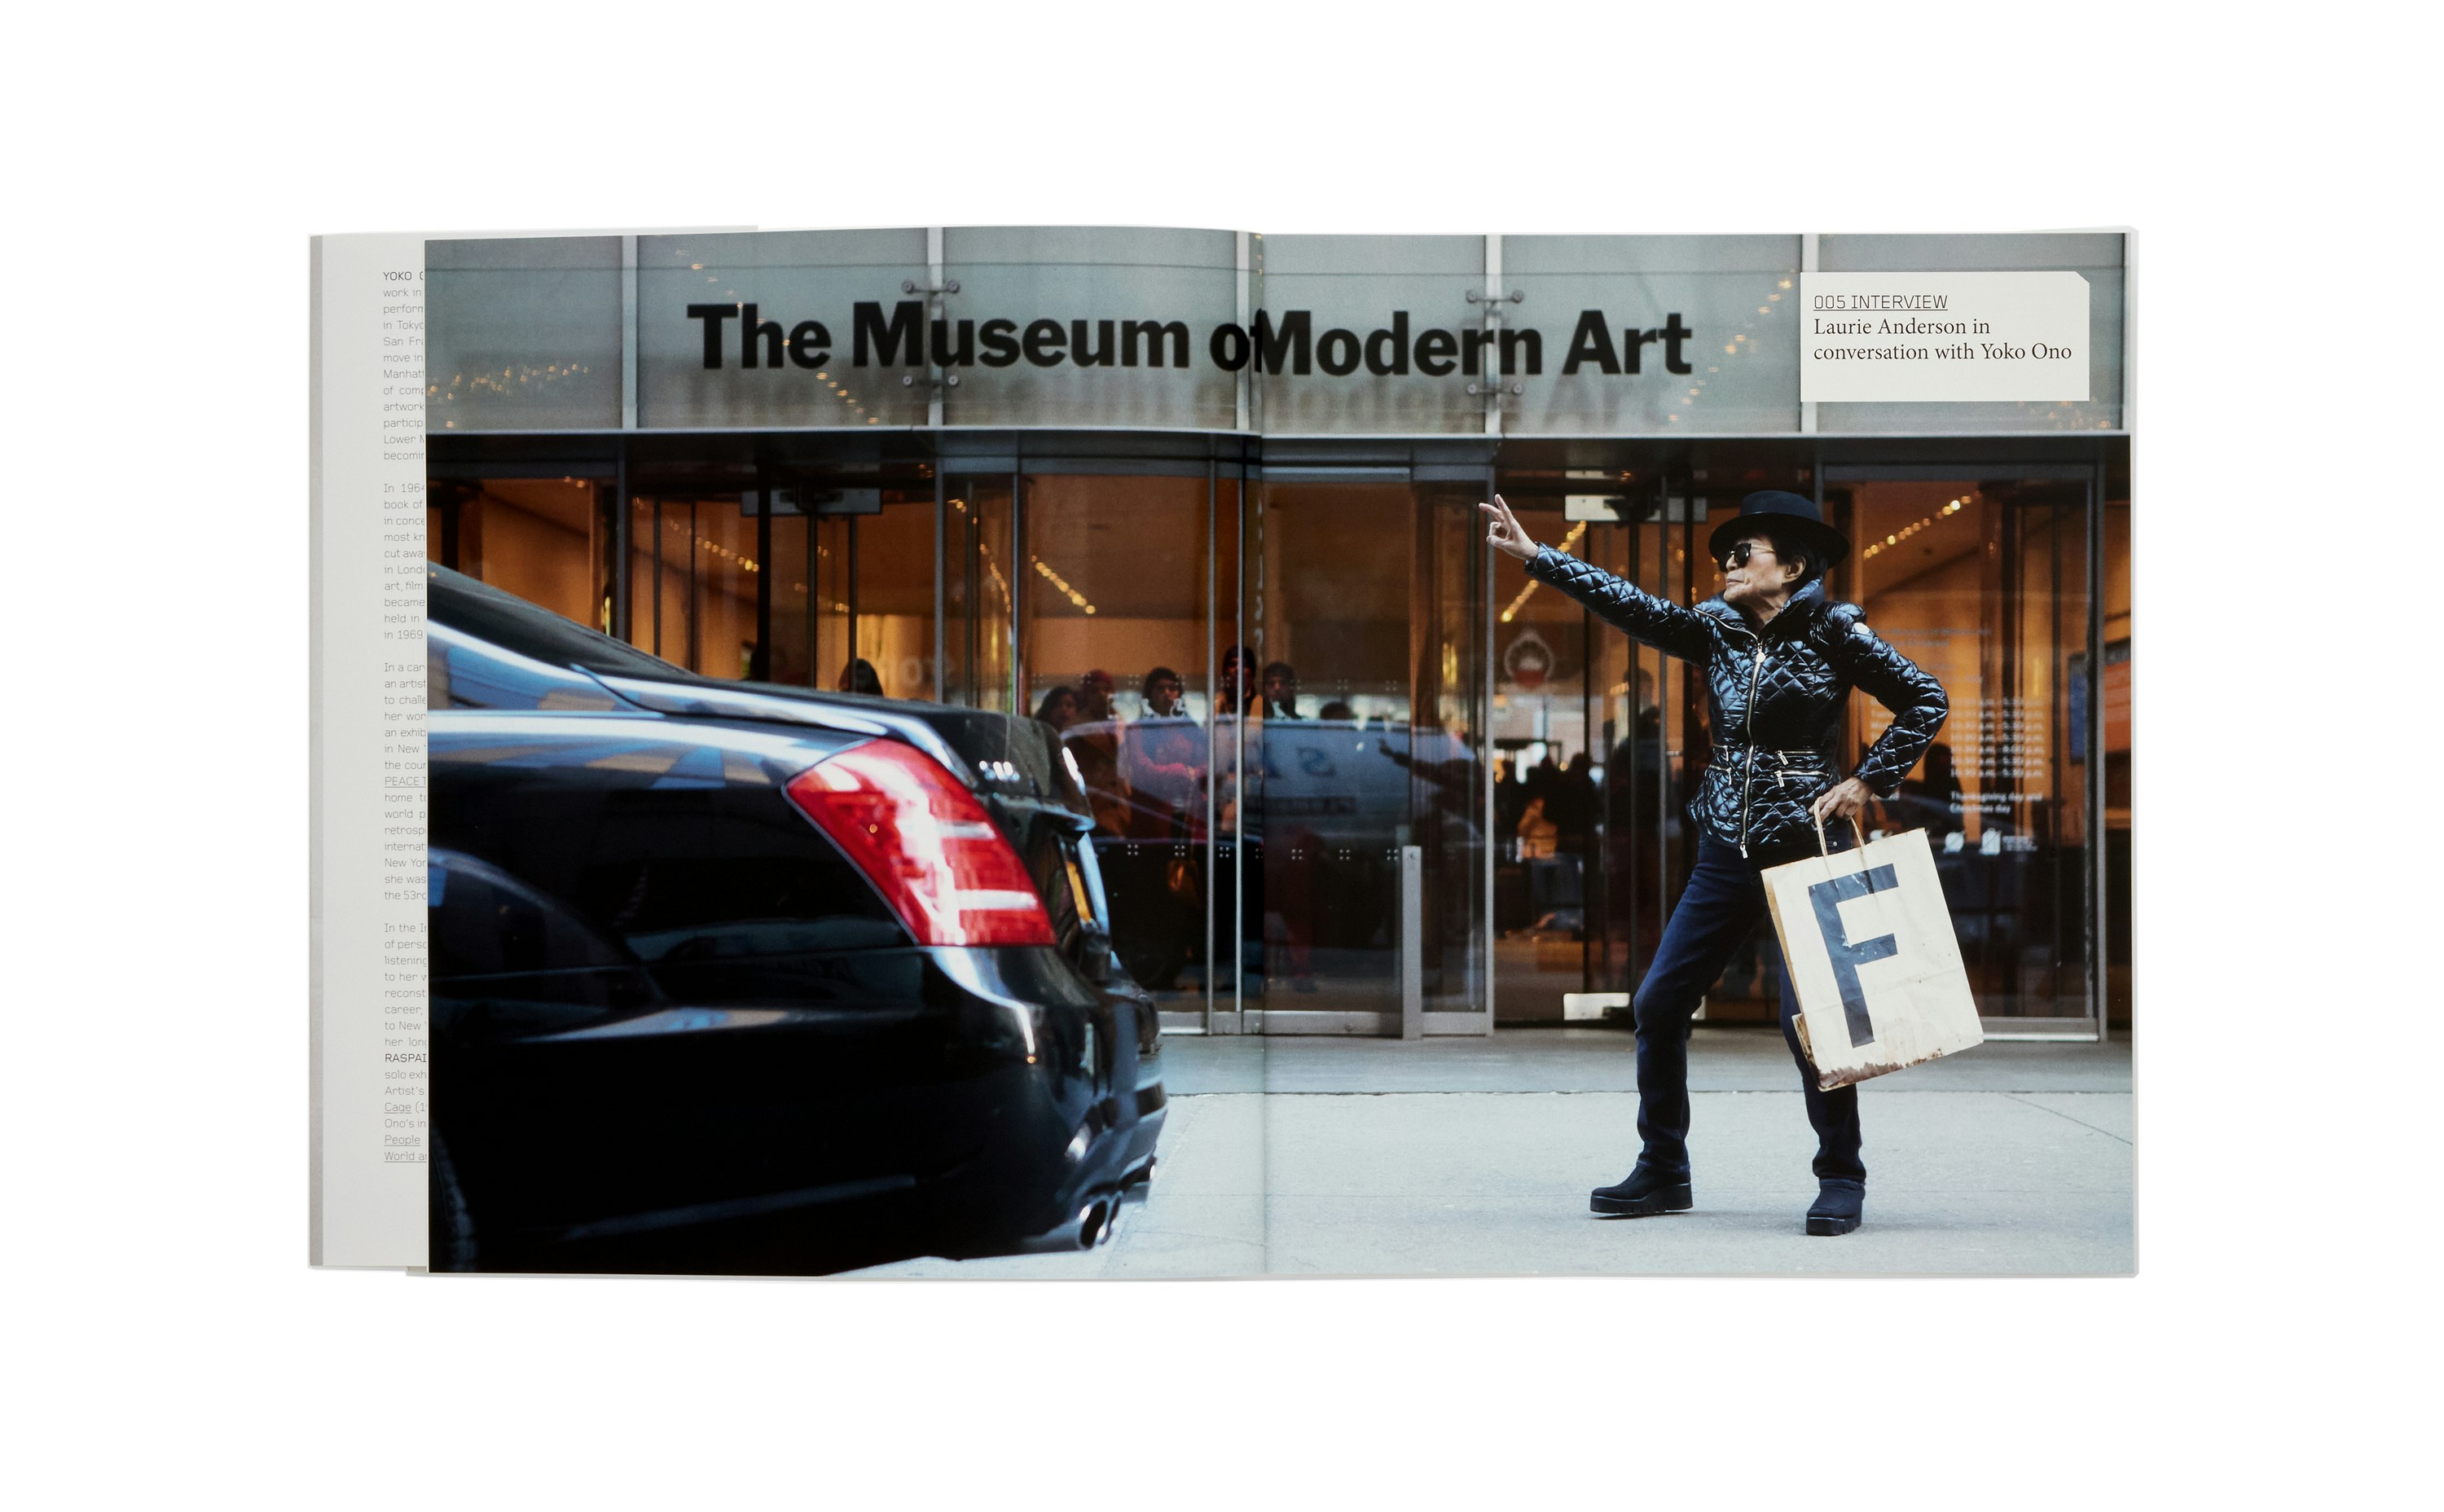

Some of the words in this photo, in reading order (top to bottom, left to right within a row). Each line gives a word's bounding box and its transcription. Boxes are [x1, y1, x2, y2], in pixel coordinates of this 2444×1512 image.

[383, 271, 411, 280] YOKO
[383, 288, 408, 297] work
[412, 288, 421, 297] in
[1814, 295, 1845, 309] 005
[1851, 295, 1948, 309] INTERVIEW
[384, 321, 392, 329] in
[1813, 318, 1872, 335] Laurie
[1877, 317, 1967, 335] Anderson
[1972, 318, 1991, 334] in
[384, 336, 403, 345] San
[687, 304, 832, 371] The
[852, 301, 1189, 369] Museum
[1262, 310, 1542, 376] Modern
[1563, 310, 1691, 375] Art
[1813, 343, 1929, 360] conversation
[1934, 342, 1975, 360] with
[1980, 342, 2026, 360] Yoko
[2031, 342, 2073, 360] Ono
[415, 354, 424, 362] in
[384, 385, 393, 394] of
[384, 402, 424, 411] artwork
[384, 418, 423, 429] particip
[385, 435, 415, 444] Lower
[385, 484, 394, 493] In
[385, 500, 409, 508] book
[413, 499, 423, 508] of
[385, 516, 393, 525] in
[385, 533, 410, 541] most
[385, 549, 400, 558] cut
[385, 565, 393, 574] in
[385, 582, 402, 591] art,
[406, 581, 423, 590] film
[385, 598, 425, 606] became
[385, 613, 407, 622] held
[411, 614, 420, 622] in
[385, 631, 393, 639] in
[398, 630, 423, 639] 1969
[385, 662, 394, 671] In
[385, 696, 394, 704] to
[385, 712, 402, 721] her
[385, 745, 393, 753] in
[398, 745, 420, 753] New
[385, 761, 401, 769] the
[385, 776, 420, 785] PEACE
[385, 793, 412, 802] home
[385, 809, 413, 818] world
[385, 826, 426, 836] retrosp
[385, 842, 426, 850] internat
[385, 858, 407, 867] New
[411, 859, 426, 867] Yor
[385, 875, 402, 883] she
[385, 891, 401, 899] the
[385, 923, 394, 932] In
[399, 924, 415, 932] the
[385, 939, 395, 948] of
[1808, 862, 1899, 1048] F
[385, 972, 395, 981] to
[399, 973, 417, 981] her
[385, 989, 426, 997] reconst
[385, 1007, 423, 1015] career,
[385, 1022, 395, 1030] to
[399, 1022, 421, 1030] New
[385, 1038, 403, 1046] her
[385, 1070, 406, 1079] solo
[385, 1086, 424, 1095] Artist's
[385, 1102, 411, 1113] Cage
[415, 1101, 427, 1114] (1
[385, 1119, 414, 1127] Ono's
[417, 1119, 426, 1127] in
[385, 1135, 420, 1145] People
[385, 1151, 415, 1160] World
